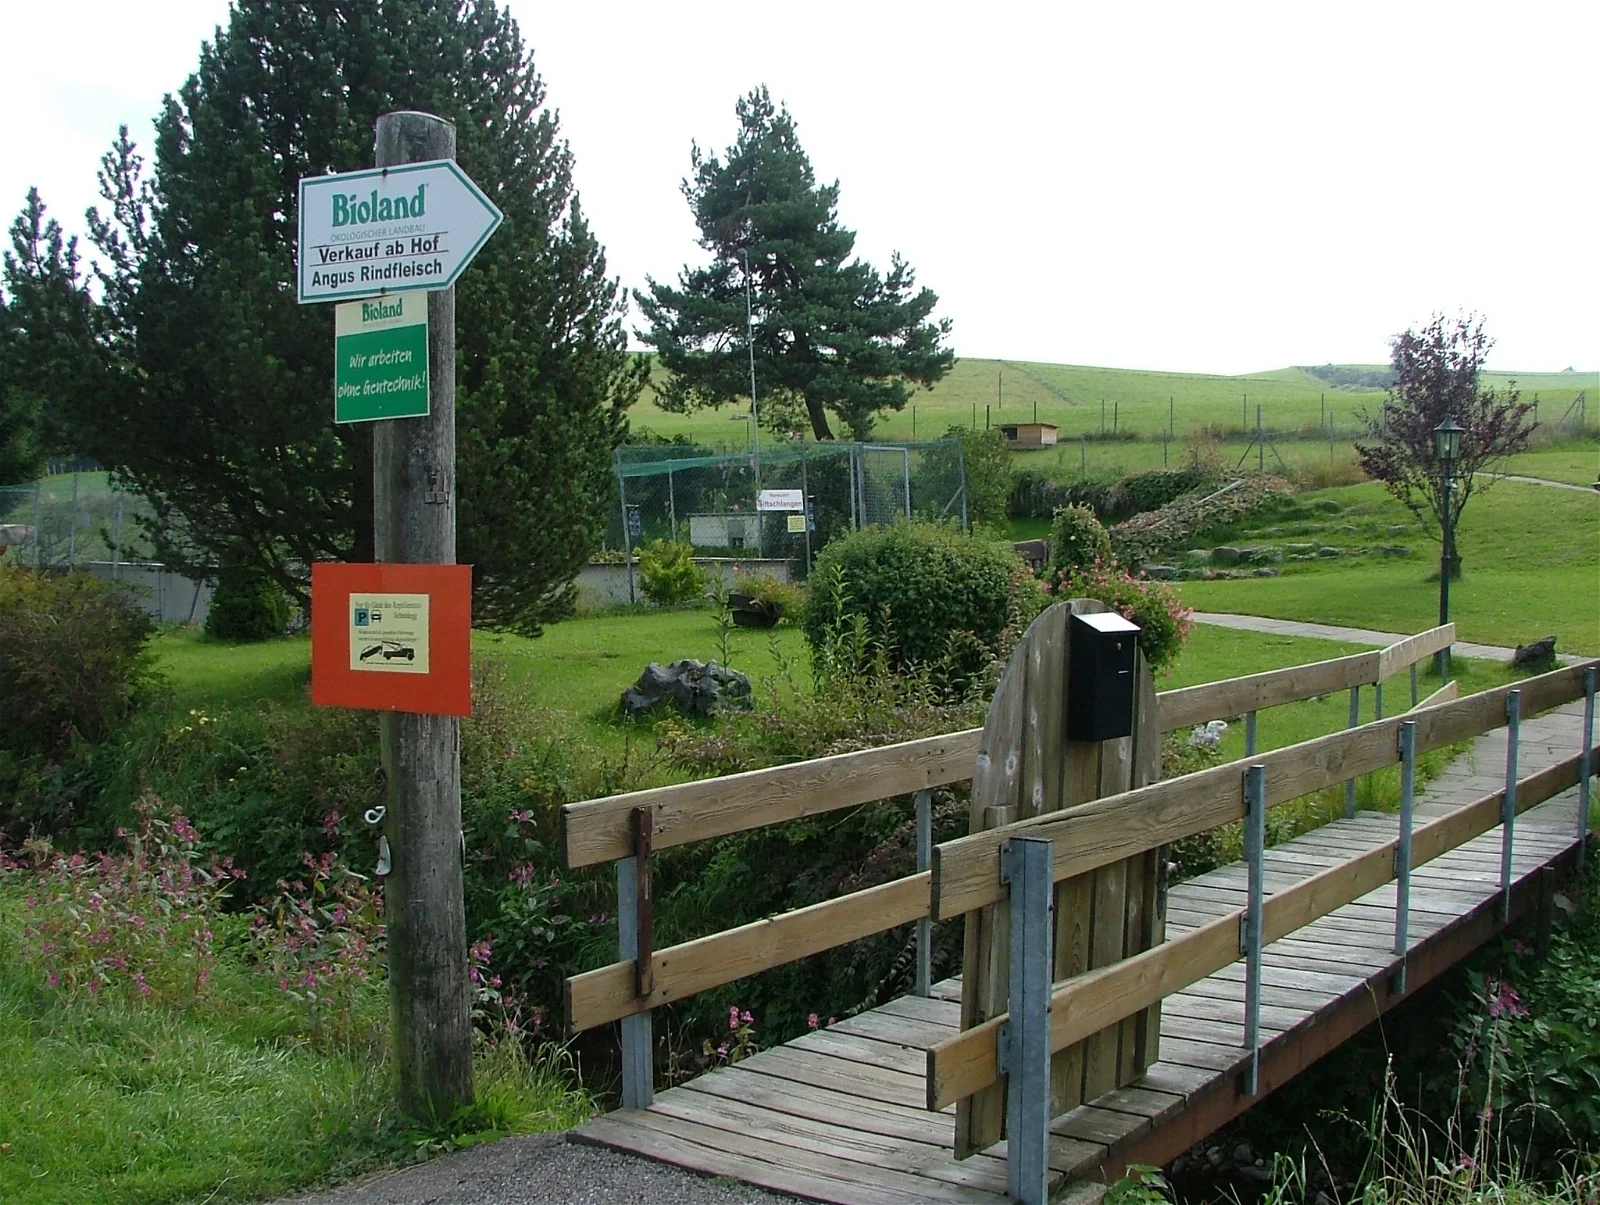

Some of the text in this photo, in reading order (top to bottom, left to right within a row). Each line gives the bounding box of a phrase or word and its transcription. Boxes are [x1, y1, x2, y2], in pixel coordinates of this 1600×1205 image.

[332, 183, 426, 227] Bioland
[330, 223, 426, 243] ÖKOLOGISCHER LANDBAU
[319, 235, 440, 264] Verkauf ab Hof
[312, 258, 443, 289] Angus Rindfleisch
[361, 297, 403, 322] Bioland
[368, 349, 413, 367] arbeiten
[337, 371, 426, 398] ohne Gentechnik!
[358, 612, 367, 623] P
